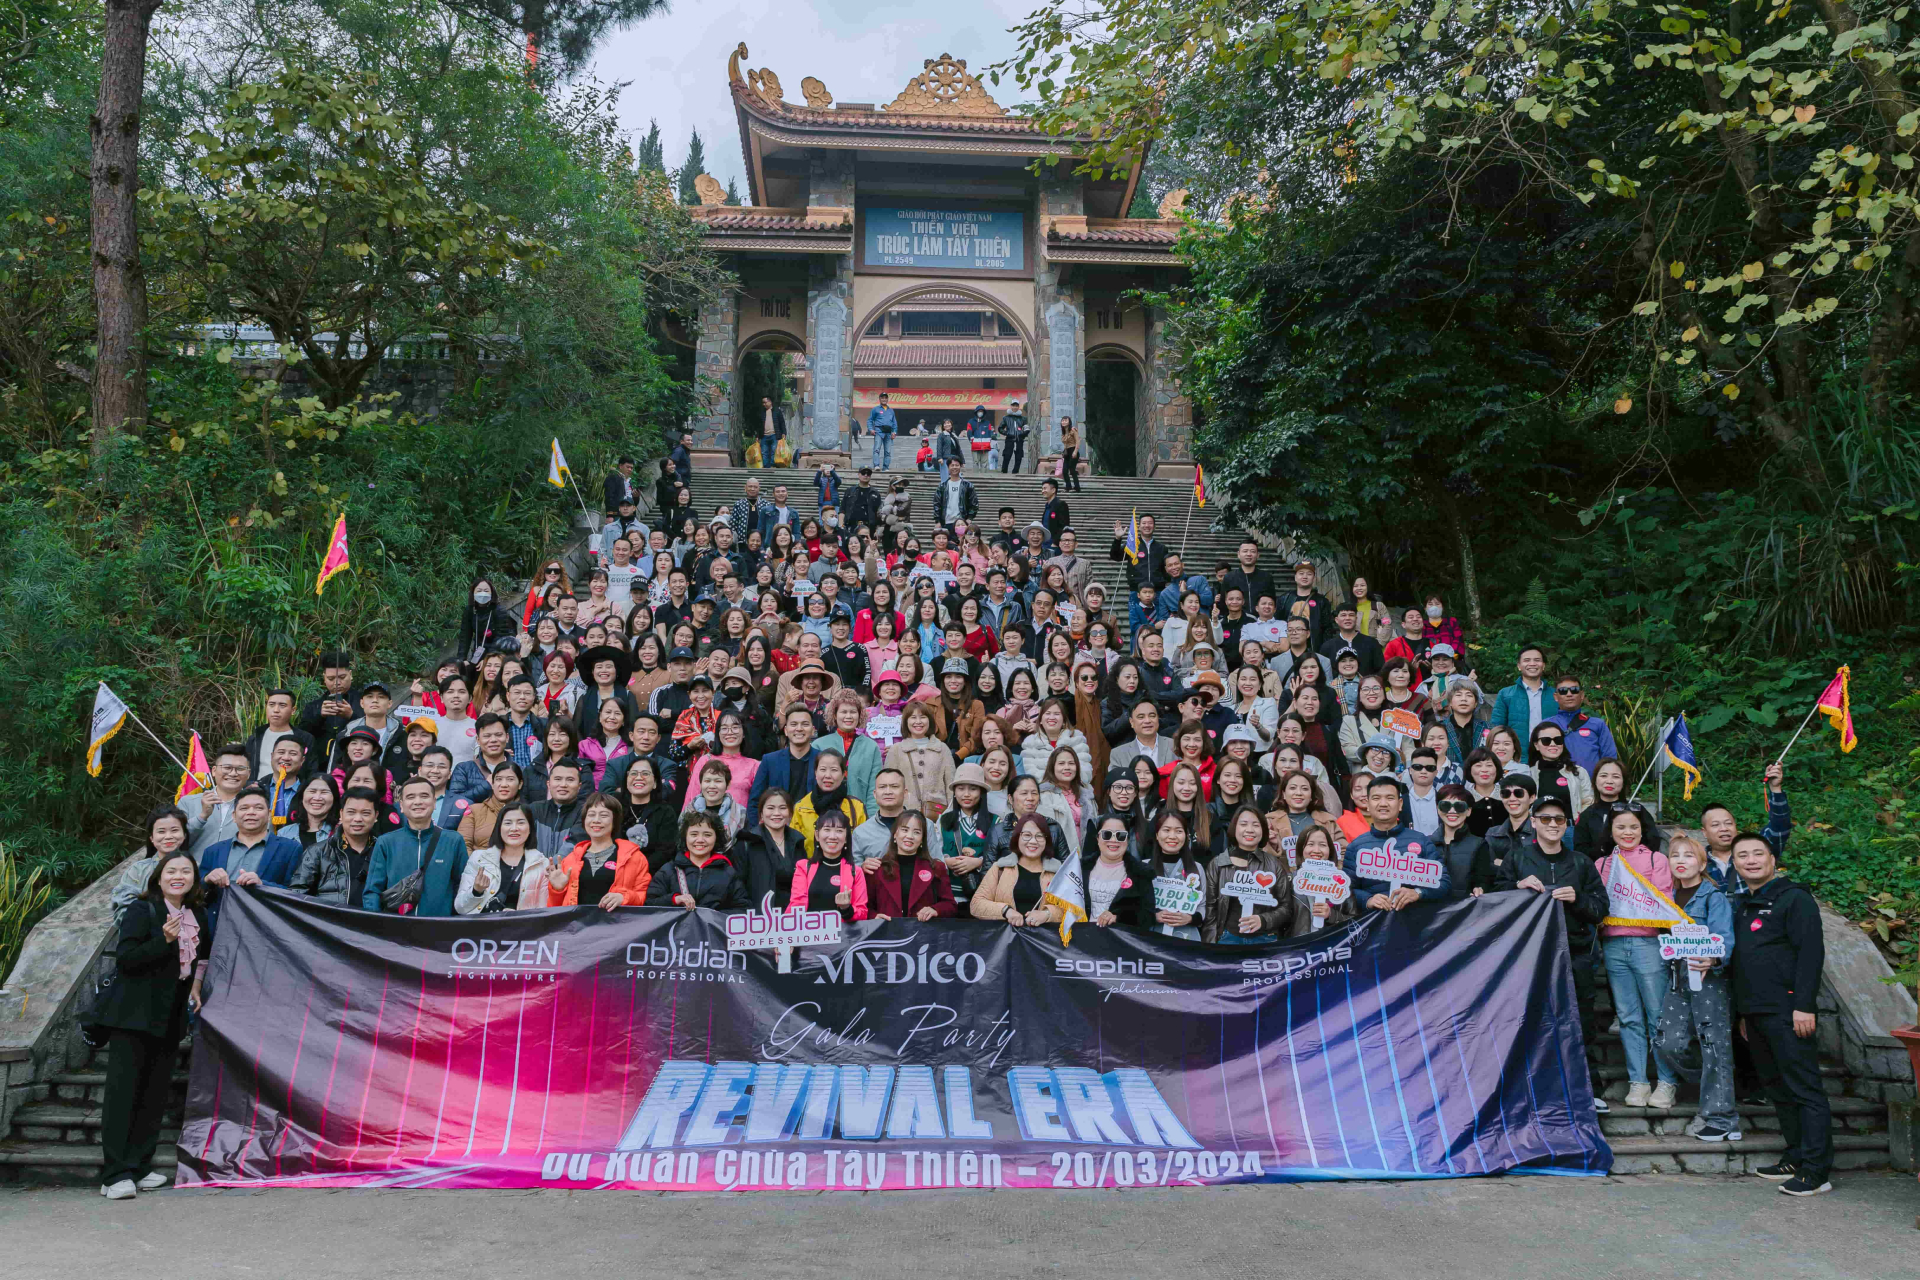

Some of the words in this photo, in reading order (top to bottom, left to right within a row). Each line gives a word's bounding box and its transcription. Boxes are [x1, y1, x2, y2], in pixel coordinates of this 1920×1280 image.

[978, 213, 992, 222] NAM
[877, 232, 910, 254] TRÚC
[913, 234, 943, 256] LÂM
[946, 235, 970, 257] TÂY
[974, 236, 1011, 258] THIÊN
[884, 256, 914, 264] PL.2549
[922, 392, 951, 403] Xuân
[400, 707, 436, 716] sophia
[1359, 842, 1439, 876] obsidian
[1157, 878, 1184, 886] sophia
[1236, 872, 1255, 884] We
[1359, 868, 1437, 884] PROFESSIONAL
[1227, 885, 1267, 895] sophia
[1298, 879, 1345, 899] Family
[1613, 881, 1661, 909] obsidian
[728, 892, 841, 936] obsidian
[1612, 893, 1659, 916] PROFESSIONAL
[626, 922, 747, 971] obsidian
[729, 934, 840, 948] PROFESSIONAL
[1661, 936, 1681, 945] Tình
[1683, 936, 1711, 946] duyên
[1676, 946, 1698, 956] phơi
[1701, 945, 1723, 956] phới
[451, 938, 560, 966] ORZEN
[1241, 946, 1352, 974] sophia
[1055, 956, 1165, 976] sophia
[1243, 964, 1354, 987] PROFESSIONAL
[626, 970, 746, 984] PROFESSIONAL
[1098, 983, 1191, 1002] platinum
[761, 1001, 876, 1060] Gala
[897, 1002, 1017, 1068] Party
[615, 1060, 993, 1151] REVIVAL
[1007, 1065, 1204, 1150] ERA
[604, 1150, 699, 1185] Xuân
[823, 1149, 887, 1189] Tây
[902, 1150, 1002, 1187] Thiên
[1018, 1166, 1037, 1176] -
[1051, 1150, 1265, 1188] 20/03/2024
